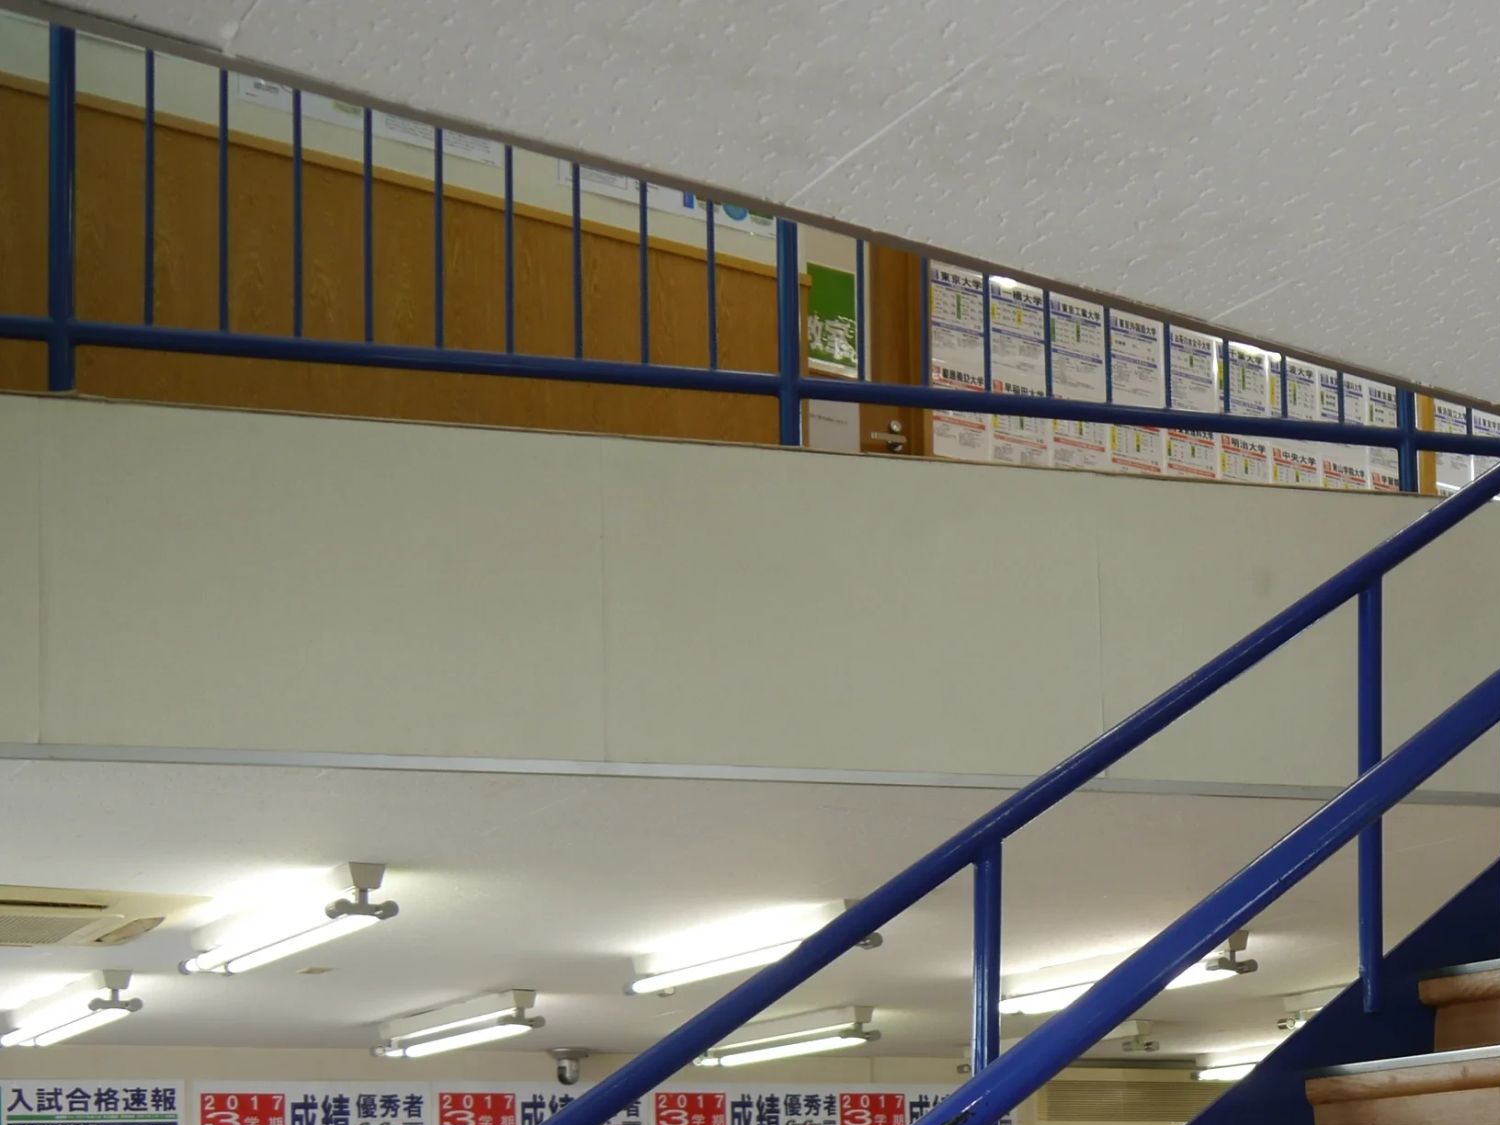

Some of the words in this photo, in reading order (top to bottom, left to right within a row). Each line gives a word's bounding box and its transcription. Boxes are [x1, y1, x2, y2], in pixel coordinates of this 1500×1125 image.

[1231, 437, 1266, 454] 明治大学
[1282, 450, 1316, 465] 中央大学
[7, 1087, 176, 1112] 入試合格速報
[204, 1095, 284, 1110] 2017
[356, 1093, 424, 1119] 優秀者
[442, 1095, 514, 1110] 2017
[658, 1094, 725, 1109] 2017
[784, 1094, 837, 1117] 優秀者
[842, 1095, 904, 1109] 2017
